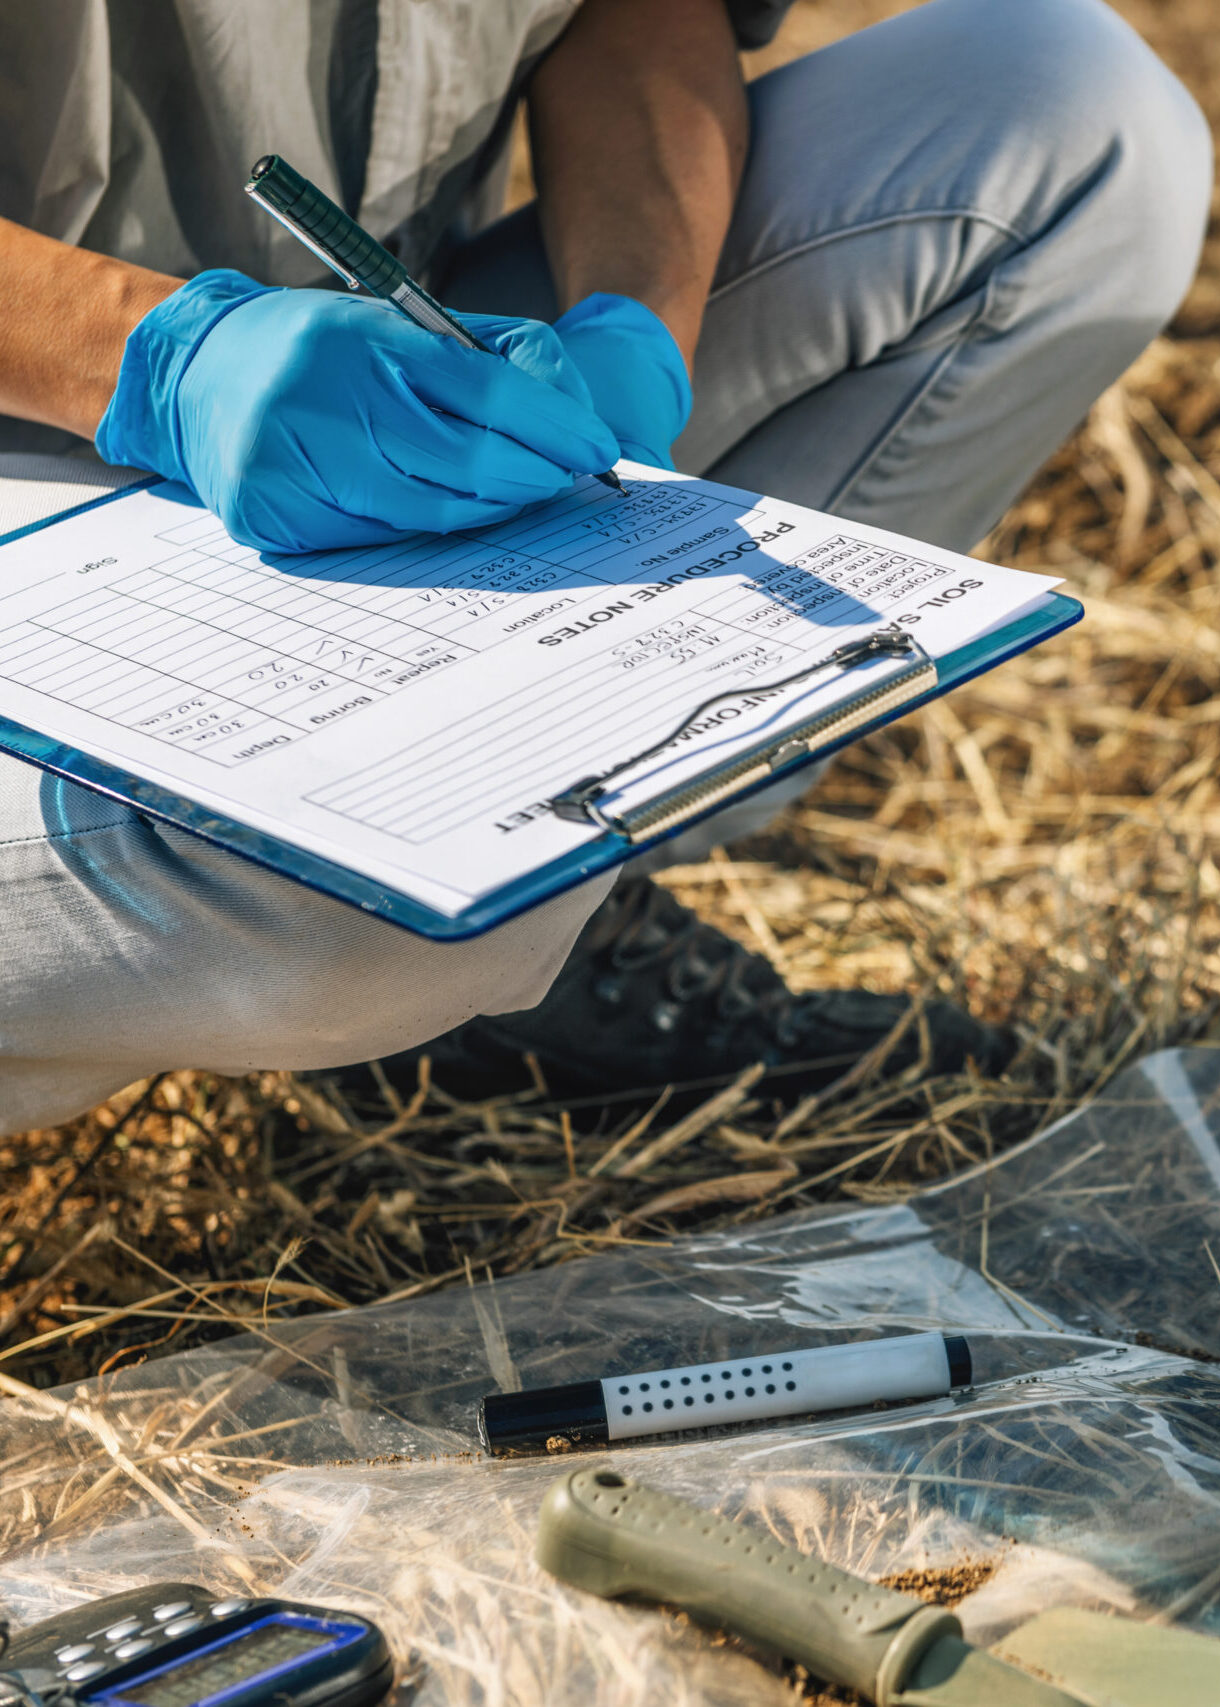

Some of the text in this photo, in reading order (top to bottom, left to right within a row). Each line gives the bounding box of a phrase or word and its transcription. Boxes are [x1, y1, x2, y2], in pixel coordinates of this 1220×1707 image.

[635, 526, 730, 569] Sample No.
[737, 537, 846, 593] Area covered:
[789, 543, 868, 585] Inspected
[75, 555, 119, 577] Sign
[537, 521, 796, 647] PROCEDURE NOTES
[741, 551, 890, 625] Time of inspection:
[761, 555, 908, 631] Date of inspection:
[883, 567, 947, 601] Project:
[916, 580, 983, 611] SOIL
[502, 598, 576, 634] Location
[247, 662, 284, 681] 20
[391, 654, 458, 685] Repeat
[308, 696, 372, 726] Boring
[231, 735, 292, 760] Depth
